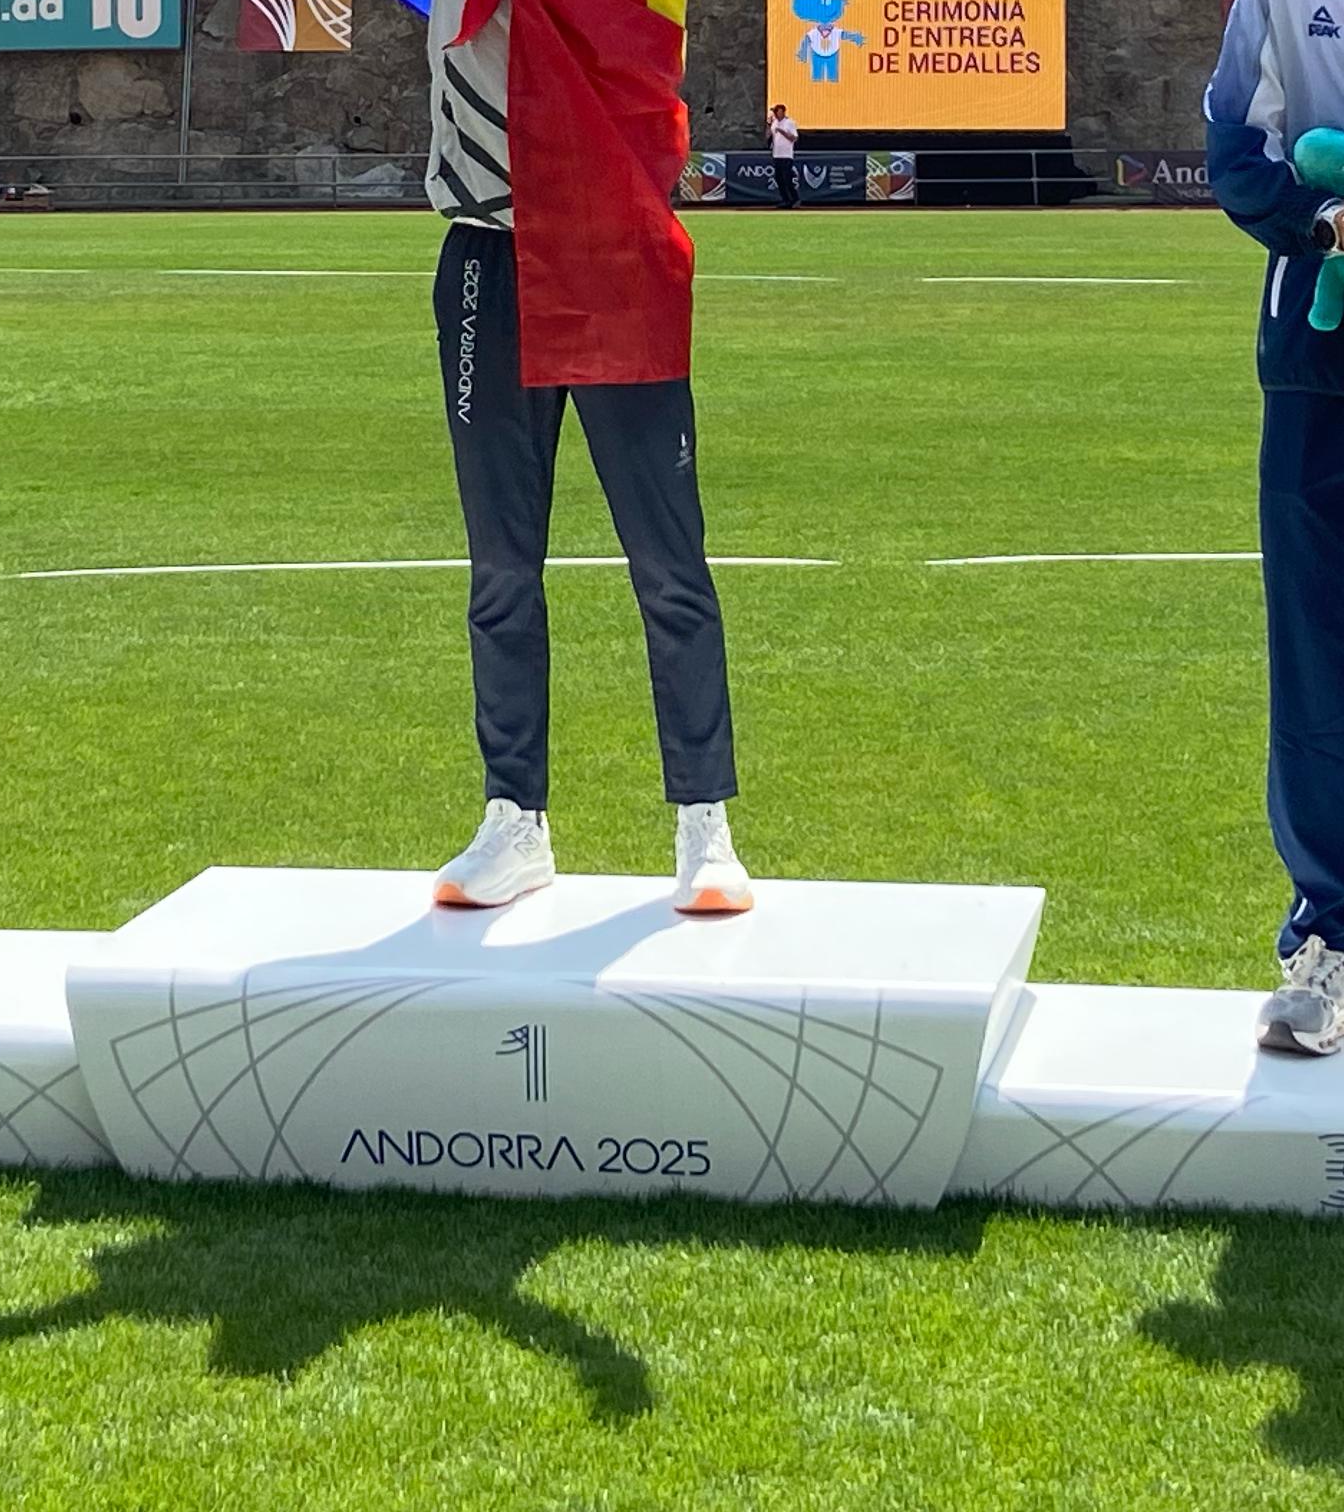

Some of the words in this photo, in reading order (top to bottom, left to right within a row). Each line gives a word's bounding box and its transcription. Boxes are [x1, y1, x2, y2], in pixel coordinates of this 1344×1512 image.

[884, 25, 1026, 48] D'ENTREGA
[1308, 24, 1342, 39] PEAK
[869, 52, 899, 73] DE
[908, 52, 1041, 73] MEDALLES
[1152, 159, 1209, 185] And
[463, 259, 482, 310] 2025
[457, 315, 477, 424] ANDORRA
[340, 1129, 585, 1172] ANDORRA
[598, 1137, 711, 1176] 2025
